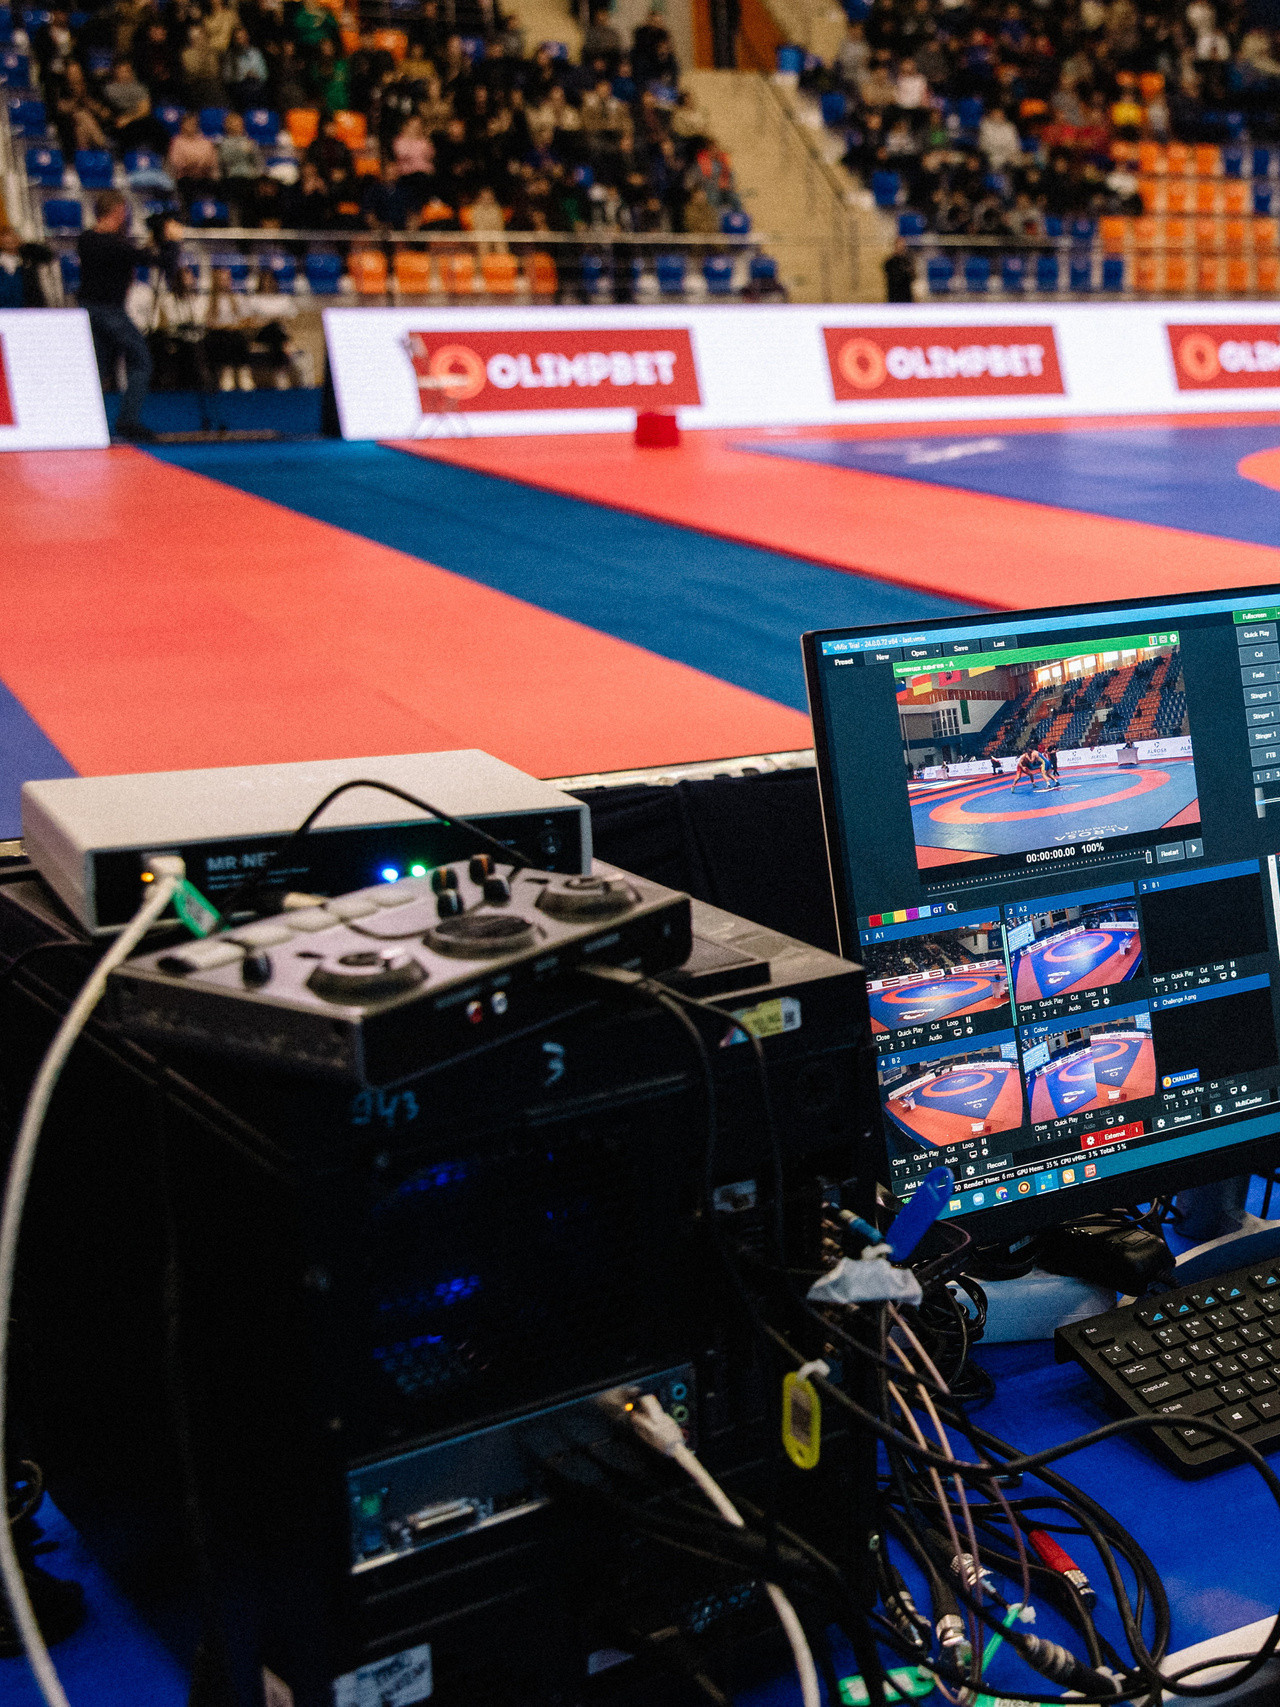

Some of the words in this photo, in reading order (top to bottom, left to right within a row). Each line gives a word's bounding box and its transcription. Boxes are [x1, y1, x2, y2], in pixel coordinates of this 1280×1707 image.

[1259, 630, 1270, 638] Play
[876, 653, 890, 661] New
[911, 649, 928, 658] Open
[835, 658, 854, 666] Preset
[1253, 671, 1265, 679] Fade
[1026, 846, 1075, 864] 00:00:00.00
[1081, 842, 1104, 854] 100%
[933, 906, 942, 914] GT
[1171, 972, 1184, 980] Quick
[1039, 1000, 1053, 1008] Quick
[1054, 998, 1063, 1006] Play
[897, 1029, 912, 1037] Quick
[913, 1026, 924, 1034] Play
[1034, 1026, 1048, 1034] Colour
[876, 1033, 890, 1042] Close
[929, 1033, 943, 1042] Audio
[1172, 1072, 1198, 1084] CHALLENGE
[1182, 1088, 1195, 1096] Quick
[1164, 1093, 1176, 1101] Close
[1235, 1097, 1263, 1108] MultiCorder
[1054, 1119, 1068, 1127] Quick
[1069, 1116, 1078, 1124] Play
[1174, 1114, 1192, 1123] Stream
[1034, 1124, 1048, 1132] Close
[1105, 1131, 1126, 1140] External
[962, 1142, 974, 1150] Loop
[913, 1152, 928, 1161] Quick
[945, 1157, 959, 1165] Audio
[892, 1158, 906, 1166] Close
[987, 1160, 1007, 1169] Record
[964, 1180, 984, 1189] Render
[984, 1177, 1000, 1185] Time:
[1017, 1168, 1028, 1176] GPU
[1029, 1164, 1044, 1173] Mem:
[1100, 1146, 1115, 1155] Total:
[905, 1181, 916, 1190] Add
[1142, 1381, 1170, 1393] CapsLock
[1169, 1404, 1183, 1412] Shift
